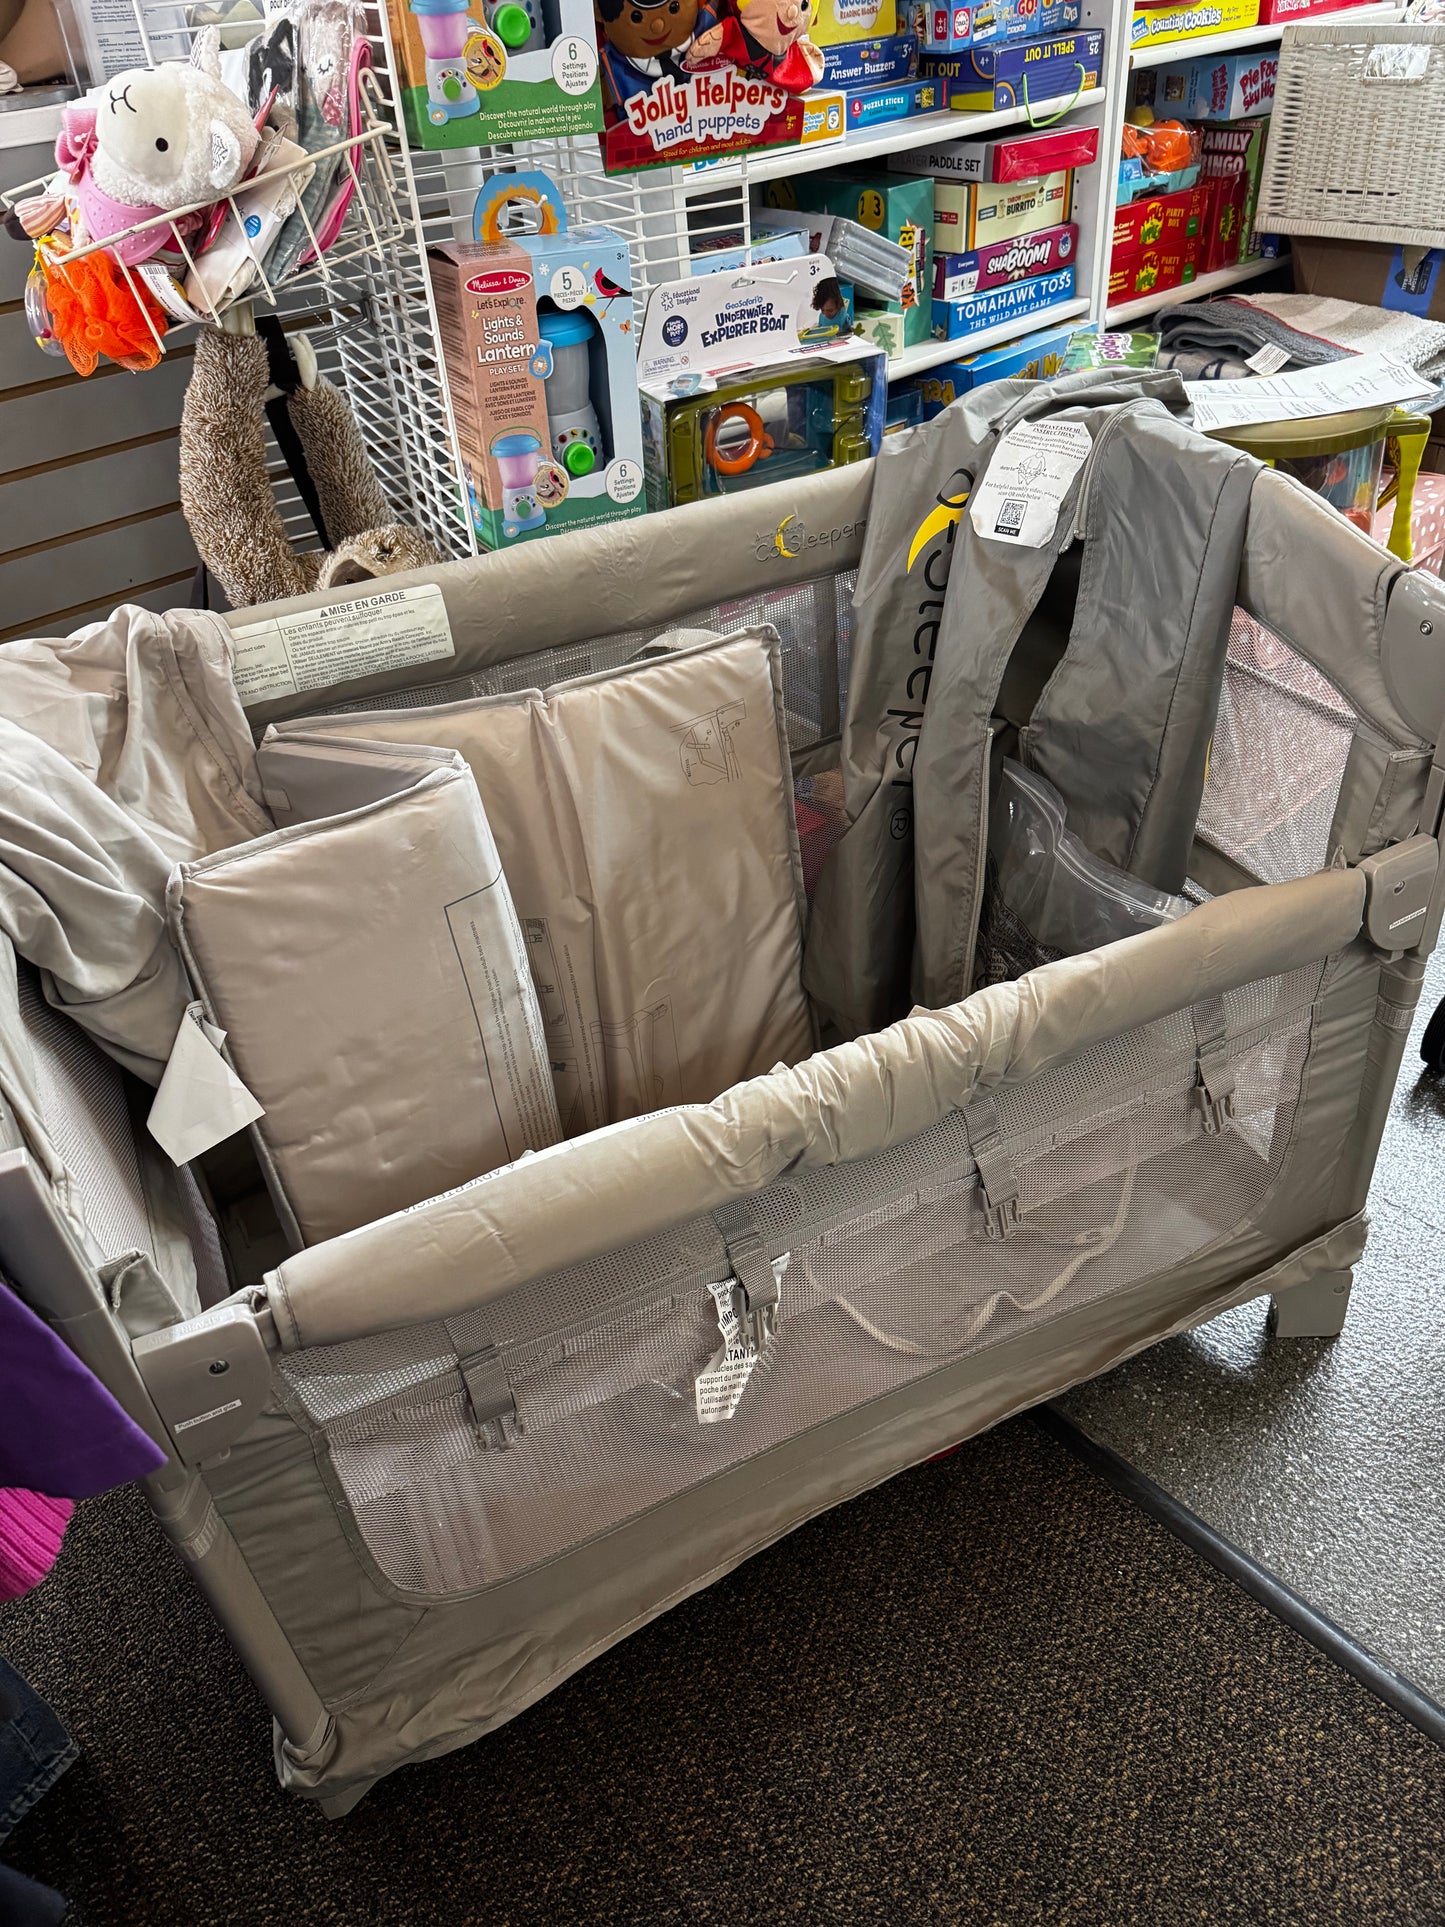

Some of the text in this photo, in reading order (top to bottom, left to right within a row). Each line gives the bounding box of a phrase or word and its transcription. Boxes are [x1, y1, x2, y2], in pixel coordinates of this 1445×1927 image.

[1151, 15, 1184, 33] Counting
[568, 43, 577, 60] 6
[902, 44, 912, 58] 3+
[1024, 41, 1075, 63] SPELL IT OUT
[562, 62, 586, 70] Settings
[830, 66, 862, 80] Answer
[864, 61, 896, 74] Buzzers
[926, 63, 960, 77] IT OUT
[562, 71, 589, 79] Positions
[565, 80, 587, 88] Ajustes
[630, 71, 784, 130] Jolly Helpers
[854, 102, 859, 110] 6
[864, 97, 904, 111] PUZZLE STICKS
[480, 110, 506, 120] Discover
[518, 107, 540, 116] natural
[542, 105, 558, 113] world
[559, 103, 583, 112] through
[584, 101, 596, 111] play
[498, 118, 527, 129] Découvrir
[535, 116, 555, 124] nature
[571, 114, 581, 123] jeu
[488, 121, 593, 140] Descubre el mundo natural jugando
[654, 113, 760, 145] hand puppets
[1204, 130, 1251, 151] AMILY
[688, 145, 709, 154] children
[929, 158, 980, 172] PADDLE SET
[1006, 198, 1035, 215] BURRITO
[1166, 208, 1185, 216] PARTY
[1168, 218, 1180, 228] BOX
[1161, 256, 1180, 265] PARTY
[810, 266, 820, 276] 3+
[472, 279, 501, 290] Melissa
[562, 272, 571, 289] 5
[673, 288, 700, 299] Educational
[677, 296, 697, 305] Insights
[957, 274, 1071, 321] TOMAHAWK TOSS
[477, 299, 493, 310] Let's
[715, 303, 773, 326] UNDERWATER
[970, 298, 1051, 330] THE WILD AXE GAME
[482, 315, 523, 331] Lights &
[484, 329, 524, 344] Sounds
[701, 315, 789, 348] EXPLORER BOAT
[477, 342, 536, 364] Lantern
[489, 366, 508, 376] PLAY
[620, 464, 627, 477] 6
[614, 477, 634, 486] Settings
[614, 484, 636, 492] Positions
[616, 490, 634, 499] Ajustes
[545, 521, 567, 531] Discover
[577, 516, 596, 527] natural
[596, 514, 610, 523] world
[610, 511, 629, 522] through
[630, 507, 641, 517] play
[328, 591, 406, 615] MISE EN GARDE
[297, 621, 322, 632] enfants
[323, 615, 351, 627] peuvent
[351, 608, 382, 620] suffoquer
[734, 1362, 744, 1370] des
[699, 1373, 731, 1384] support du
[699, 1384, 727, 1395] poche de
[701, 1394, 731, 1404] l'utilisation
[701, 1405, 729, 1414] autonome
